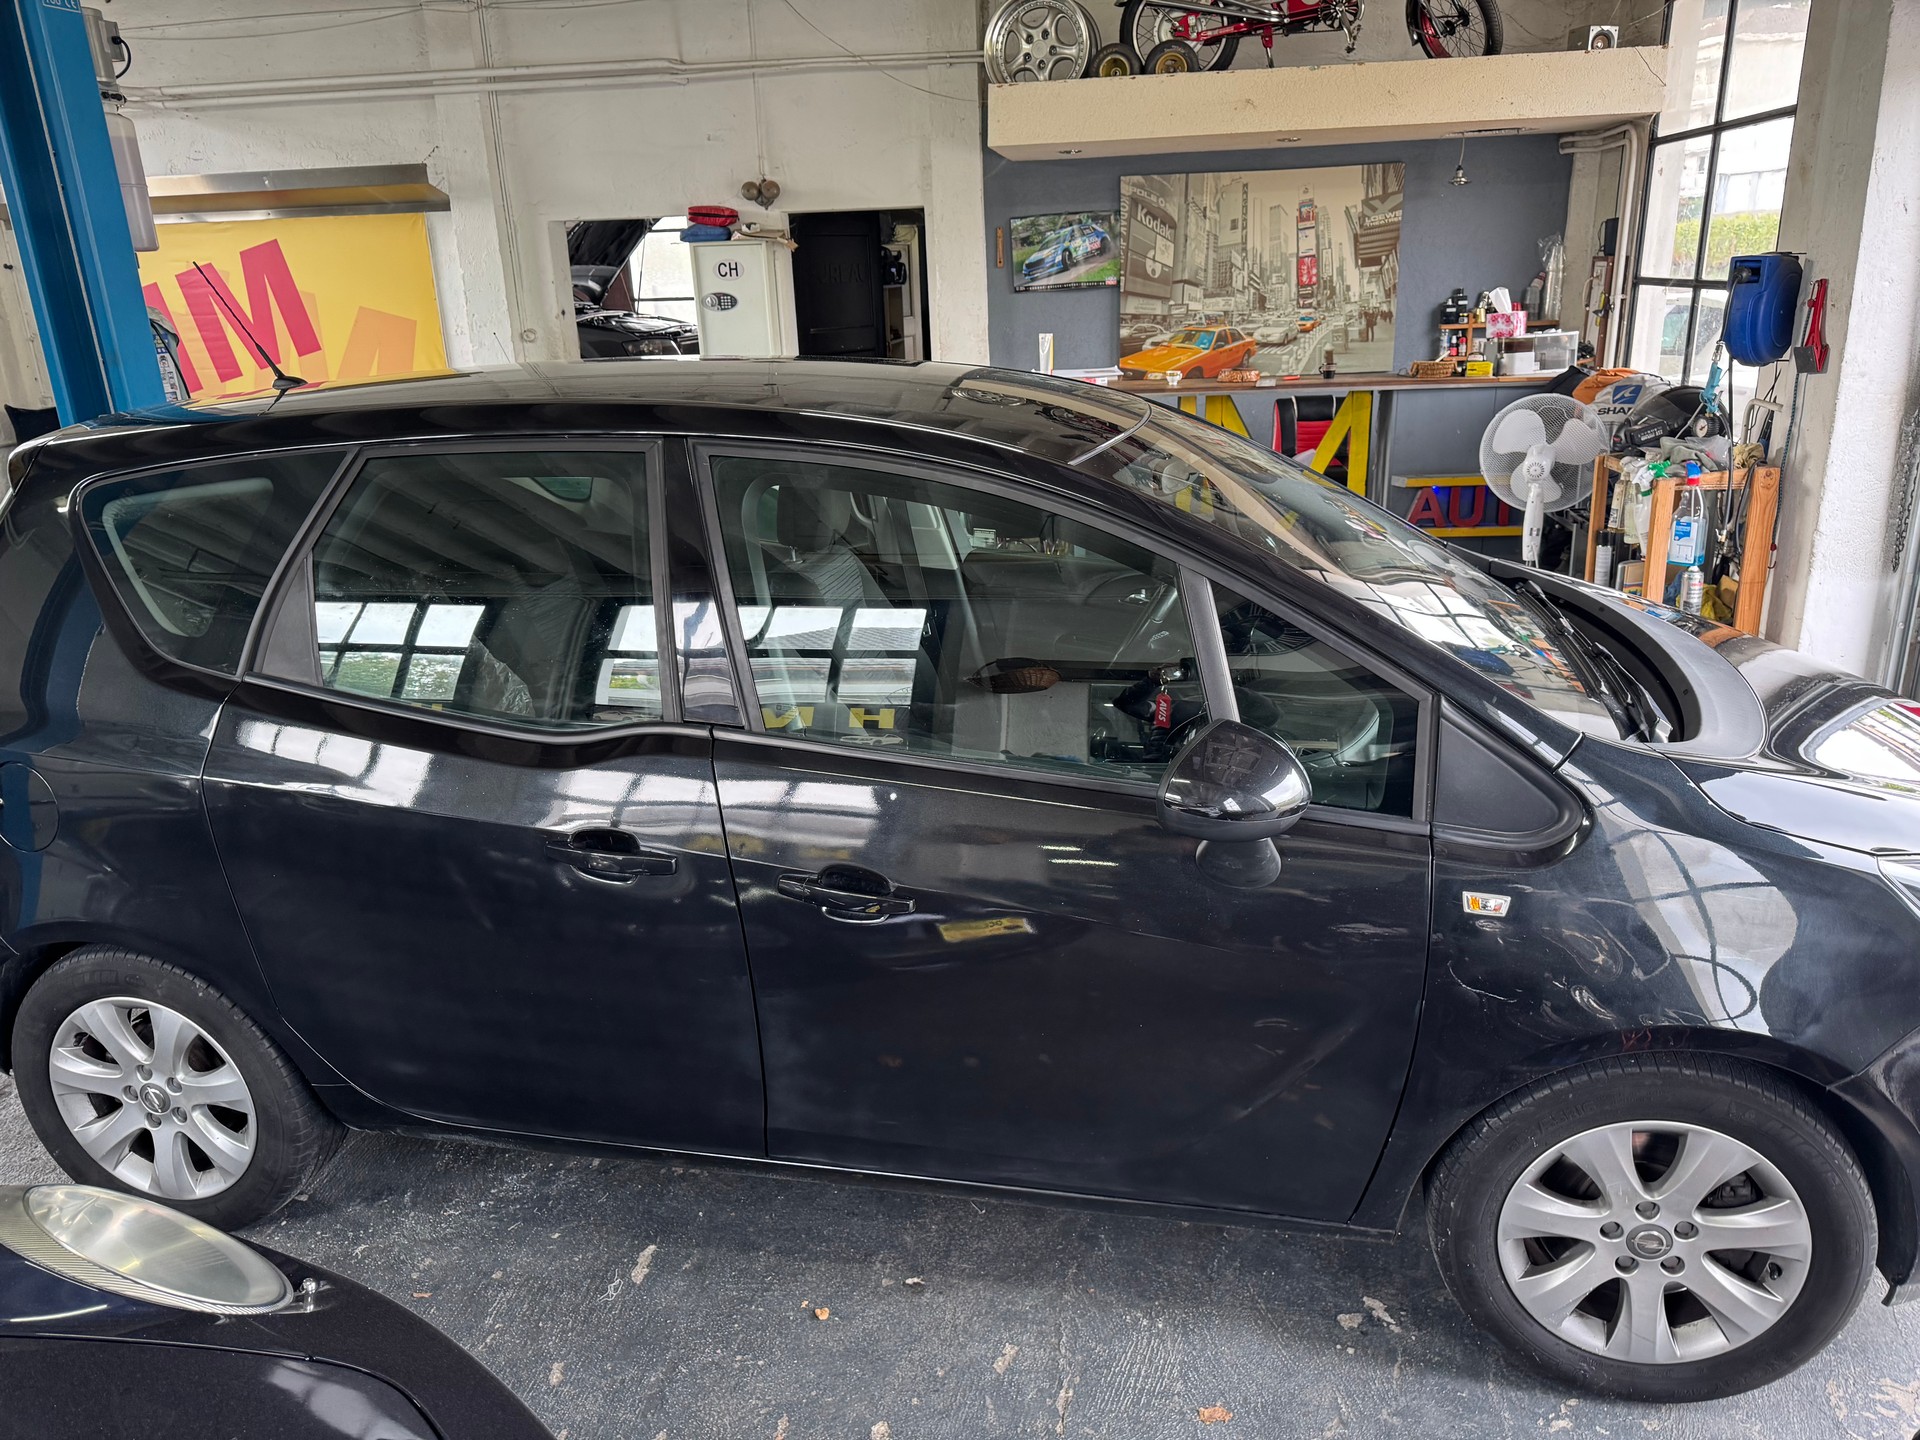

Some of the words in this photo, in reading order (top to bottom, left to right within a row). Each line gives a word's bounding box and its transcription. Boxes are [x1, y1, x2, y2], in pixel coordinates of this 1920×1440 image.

[1137, 203, 1172, 240] Kodak
[717, 262, 739, 278] CH
[1158, 699, 1167, 722] AVIS
